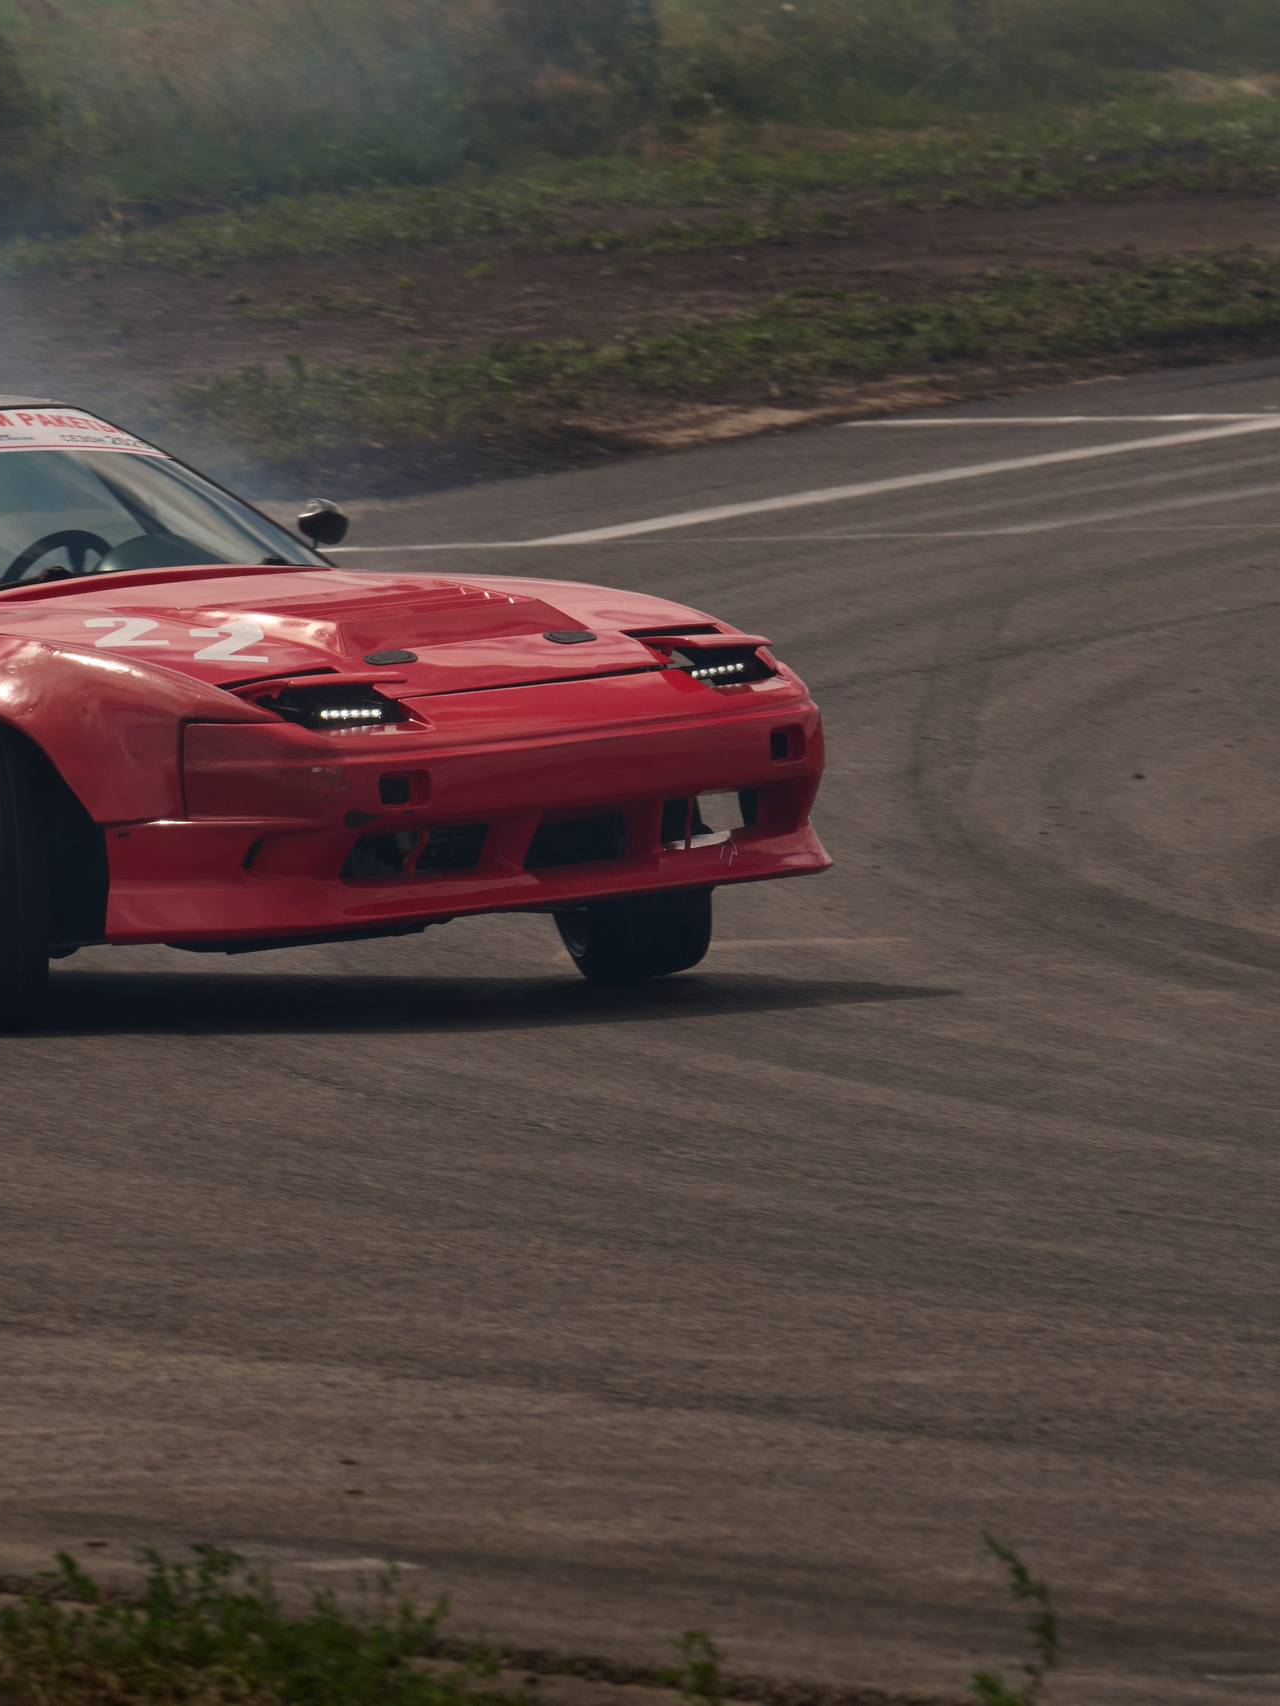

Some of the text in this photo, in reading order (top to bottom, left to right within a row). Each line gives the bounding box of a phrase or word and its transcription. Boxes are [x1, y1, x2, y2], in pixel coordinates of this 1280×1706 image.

[16, 412, 125, 434] РАКЕТЫ
[60, 433, 104, 443] СЕЗОН
[83, 616, 269, 663] 22
